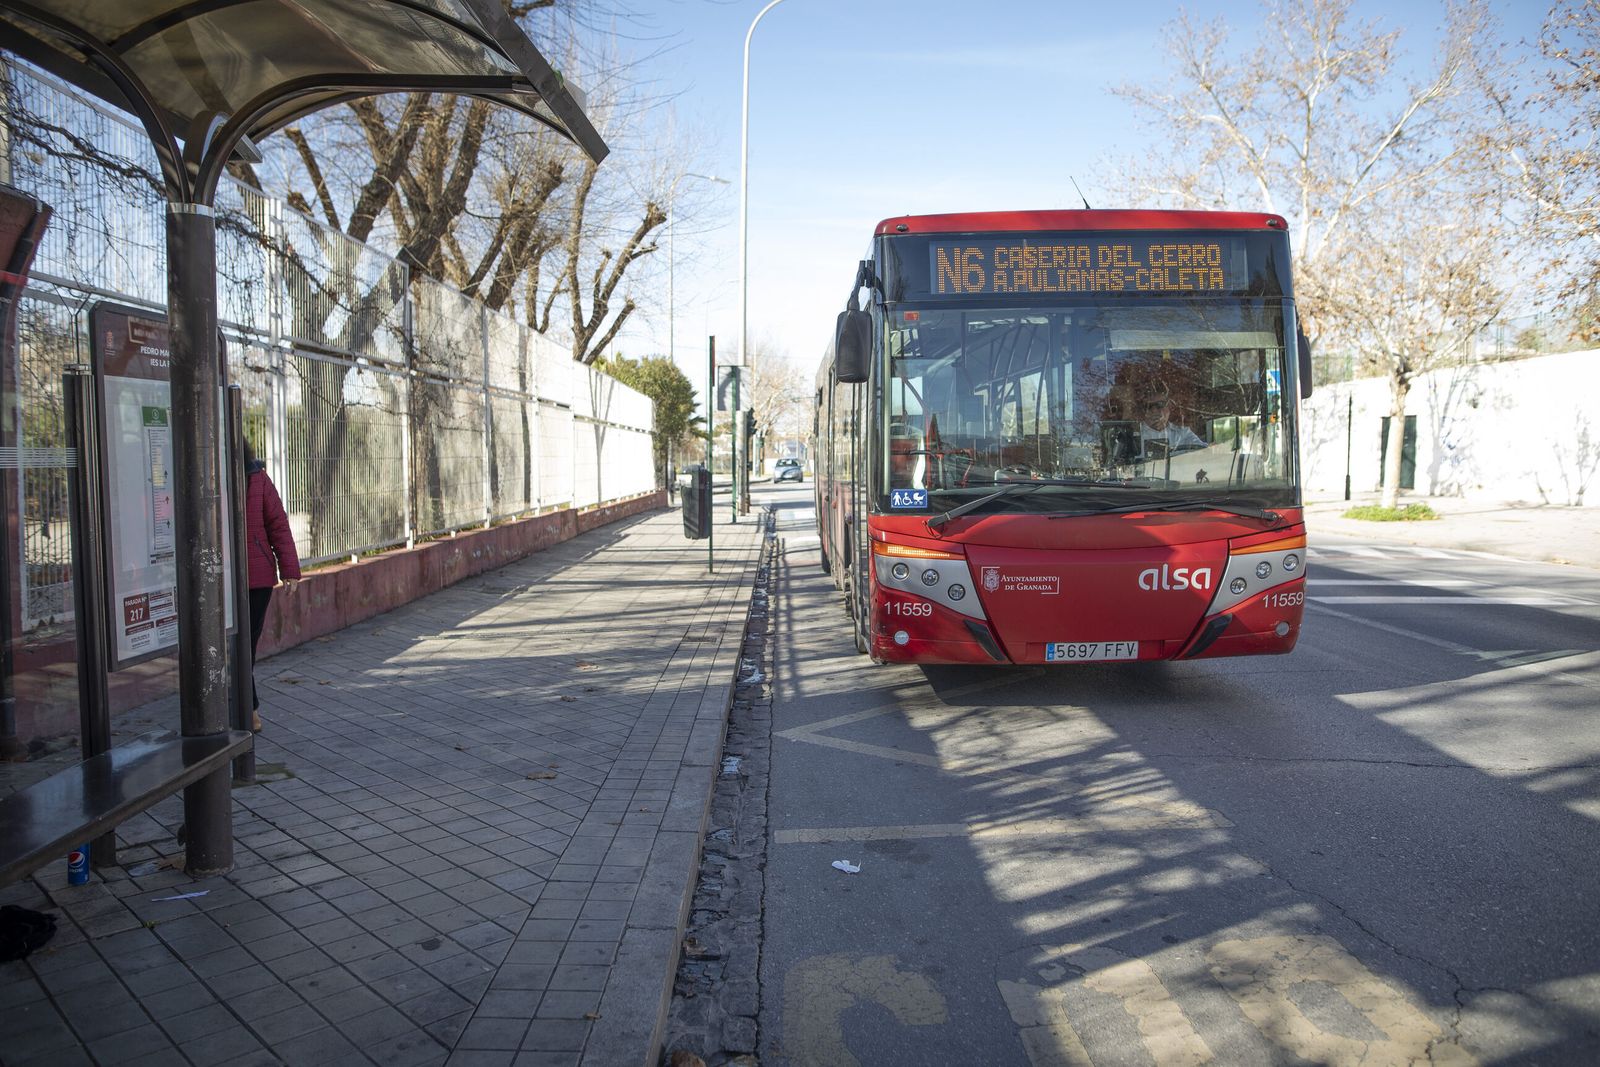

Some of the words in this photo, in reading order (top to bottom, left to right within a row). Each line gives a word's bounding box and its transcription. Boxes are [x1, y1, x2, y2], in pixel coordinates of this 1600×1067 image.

[994, 245, 1091, 268] CASERIA
[1098, 245, 1141, 267] DEL
[1148, 244, 1222, 266] CERRO
[937, 247, 985, 293] N6
[993, 268, 1224, 292] A.PULIANAS-CALETA
[140, 346, 159, 355] PEDRO
[1138, 564, 1211, 591] alsa
[124, 598, 142, 607] PARADA
[1262, 591, 1304, 609] 11559
[130, 608, 144, 622] 217
[883, 601, 933, 617] 11559
[1057, 644, 1098, 658] 5697
[1104, 643, 1135, 657] FFV
